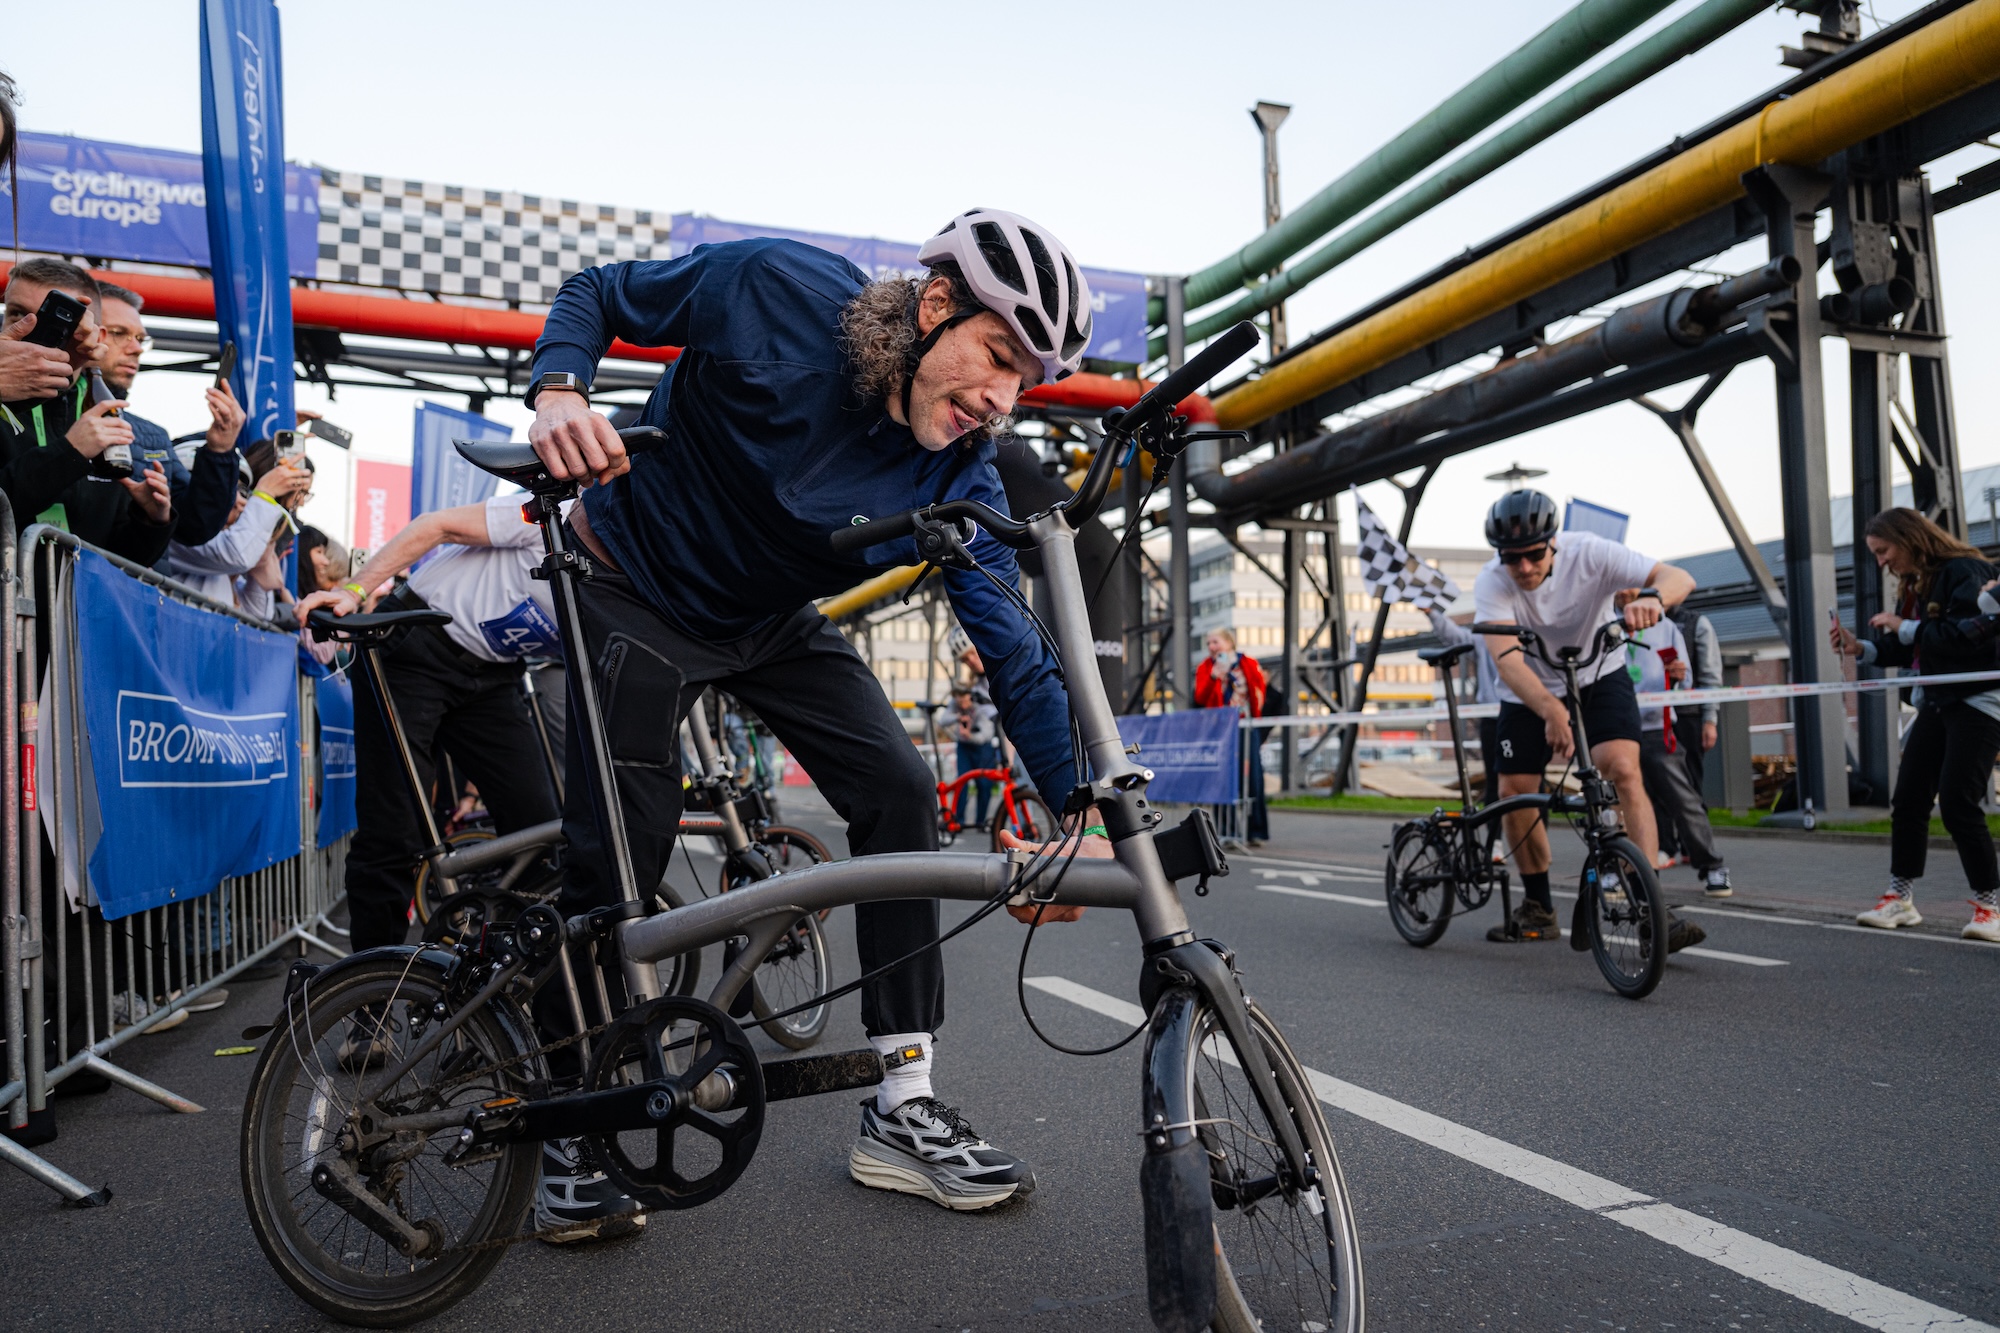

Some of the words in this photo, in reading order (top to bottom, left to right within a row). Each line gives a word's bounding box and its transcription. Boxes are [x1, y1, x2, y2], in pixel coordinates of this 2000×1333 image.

[51, 169, 206, 207] cyclingwo
[50, 194, 161, 228] europe
[501, 627, 543, 655] 44
[128, 720, 247, 764] BROMPTON
